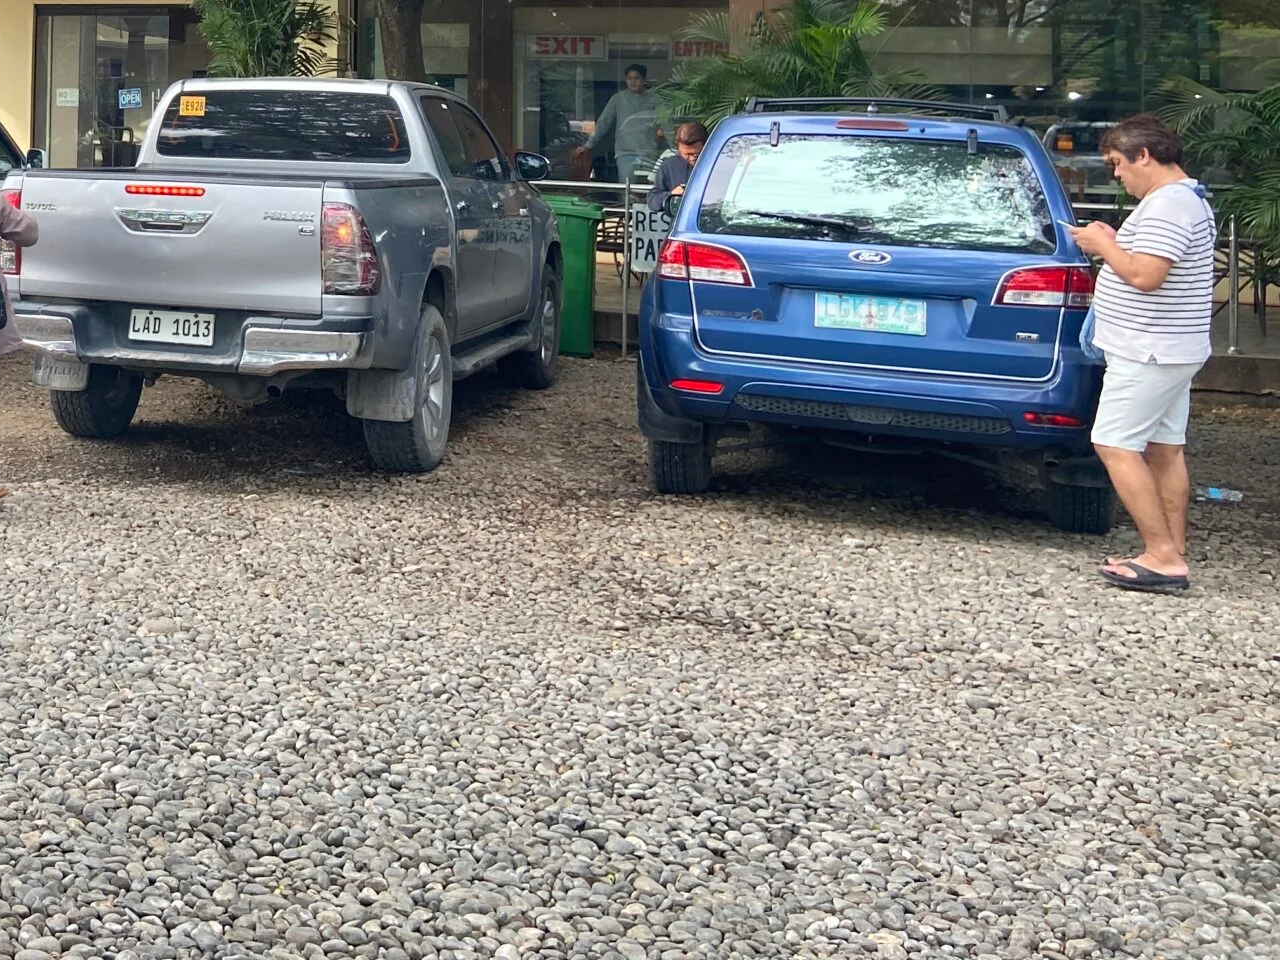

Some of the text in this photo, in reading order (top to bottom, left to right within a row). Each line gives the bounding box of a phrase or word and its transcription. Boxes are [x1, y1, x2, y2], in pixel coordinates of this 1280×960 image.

[535, 36, 596, 56] EXIT
[121, 93, 140, 105] OPEN
[185, 100, 204, 112] E928
[132, 315, 212, 338] LAD 1013
